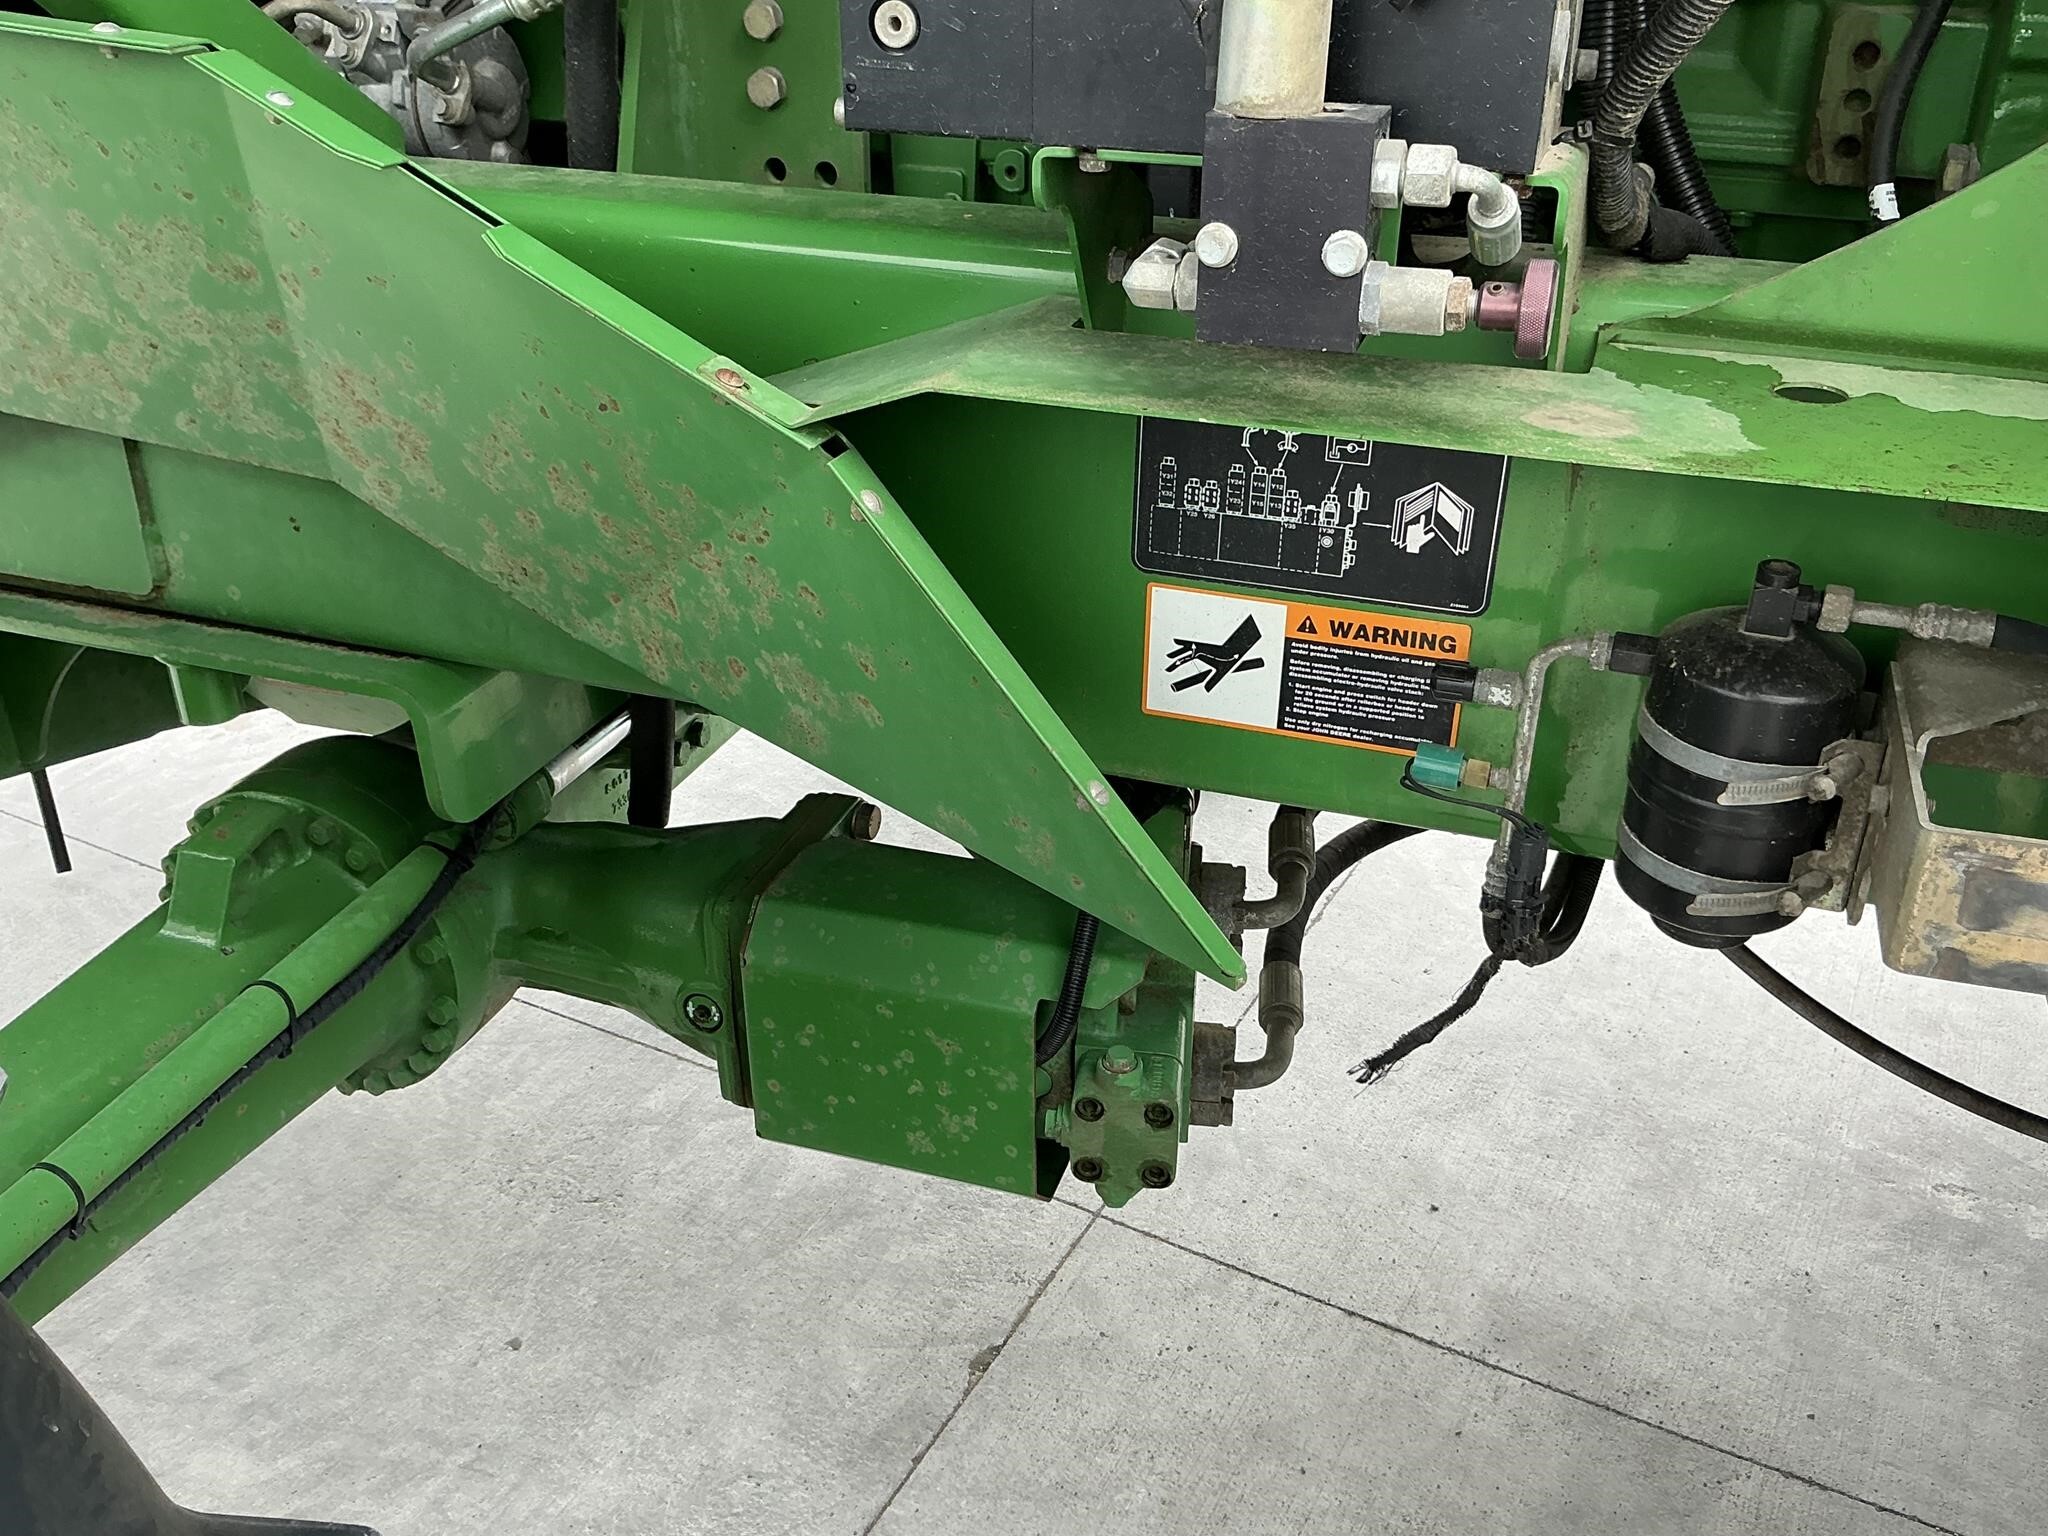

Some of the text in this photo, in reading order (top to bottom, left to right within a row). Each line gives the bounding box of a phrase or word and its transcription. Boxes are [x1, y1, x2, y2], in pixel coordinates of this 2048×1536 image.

[1329, 619, 1457, 654] WARNING
[1310, 644, 1329, 652] bodily
[1330, 647, 1353, 655] injuries
[1371, 653, 1400, 662] hydraulic
[1310, 652, 1339, 660] pressure.
[1289, 658, 1310, 666] Before
[1311, 662, 1342, 671] removing,
[1343, 667, 1387, 678] disassembling
[1397, 675, 1425, 684] charging
[1312, 670, 1351, 678] accumulator
[1360, 676, 1389, 685] removing
[1390, 680, 1419, 689] hydraulic
[1288, 672, 1332, 683] disassembling
[1333, 679, 1386, 691] electro-hydraulic
[1293, 707, 1307, 715] Stop
[1314, 693, 1340, 701] seconds
[1394, 704, 1417, 712] header
[1314, 699, 1336, 707] ground
[1359, 706, 1390, 715] supported
[1391, 710, 1417, 719] position
[1398, 698, 1420, 706] header
[1338, 708, 1367, 718] hydraulic
[1368, 714, 1396, 722] pressure
[1323, 723, 1348, 731] nitrogen
[1359, 729, 1393, 739] recharging
